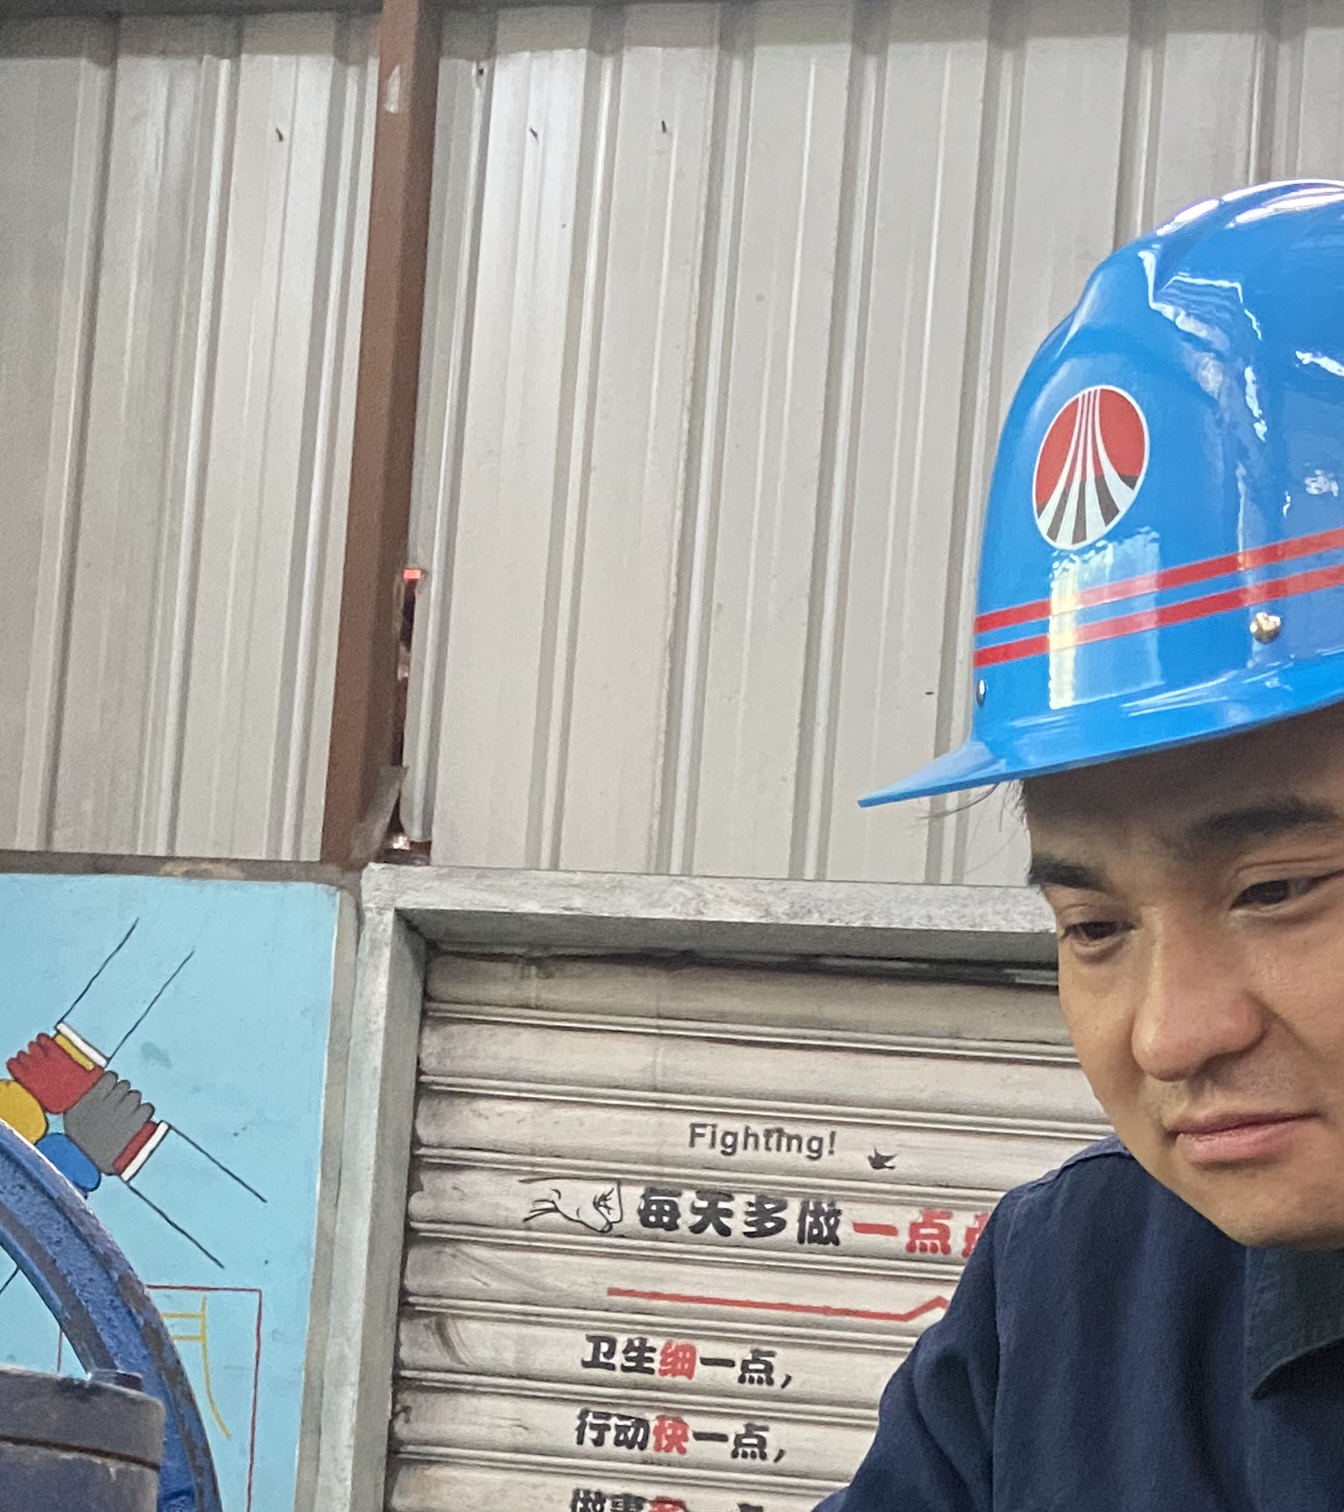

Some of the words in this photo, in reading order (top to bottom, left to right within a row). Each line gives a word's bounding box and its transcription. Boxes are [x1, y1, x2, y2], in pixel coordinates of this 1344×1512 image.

[688, 1122, 837, 1161] Fighting!
[581, 1333, 792, 1389] 卫生细一点，
[575, 1408, 786, 1463] 行动快一点，
